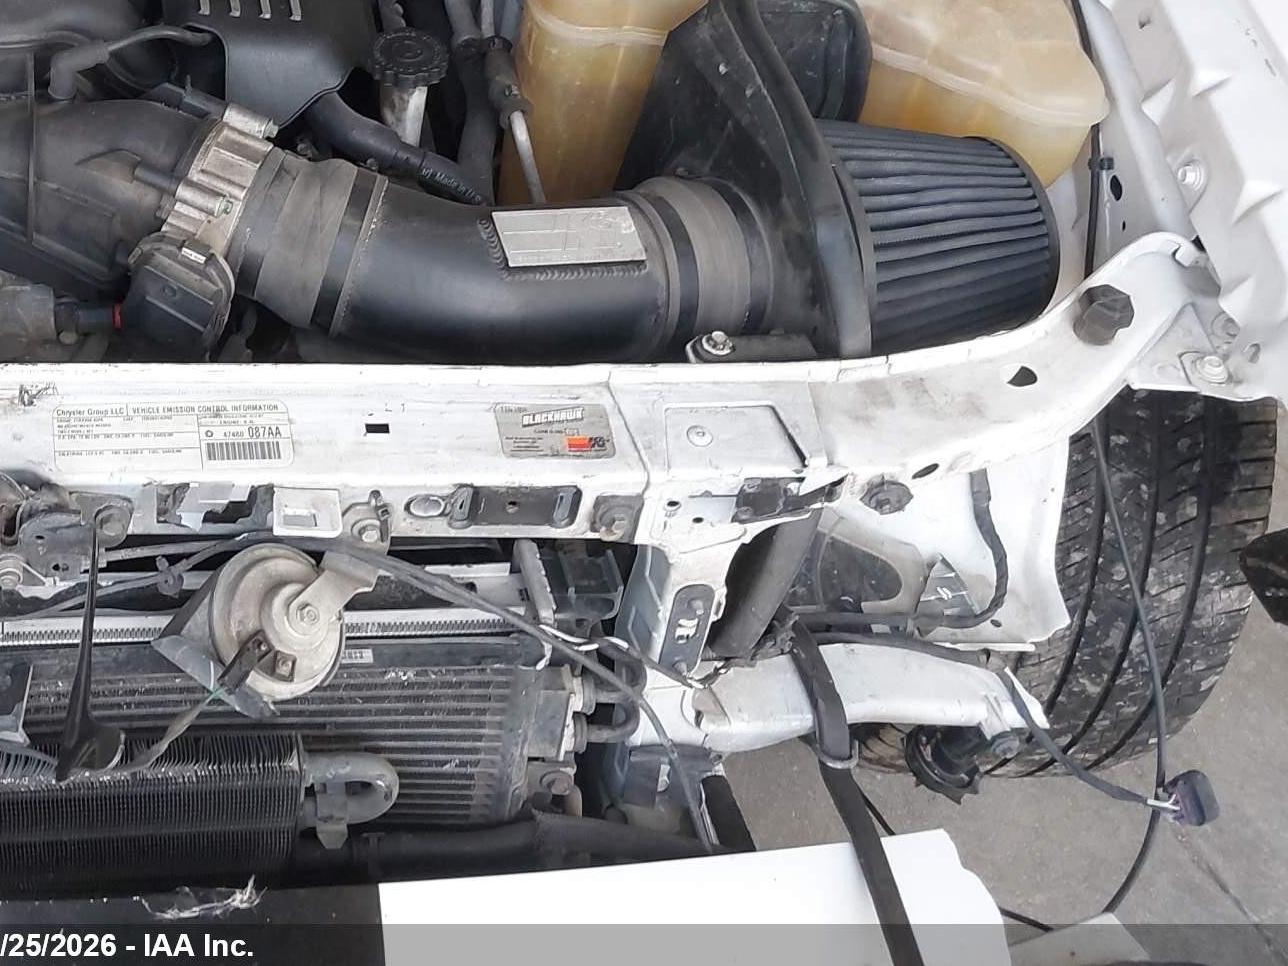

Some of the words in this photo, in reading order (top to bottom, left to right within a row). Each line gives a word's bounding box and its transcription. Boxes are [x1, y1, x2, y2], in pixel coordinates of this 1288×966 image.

[434, 172, 458, 188] Made
[56, 408, 85, 418] Chrysler
[87, 408, 109, 417] Group
[110, 407, 125, 415] LLC
[132, 406, 160, 414] VEHICLE
[162, 405, 196, 414] EMISSION
[197, 404, 229, 413] CONTROL
[231, 403, 279, 412] INFORMATION
[248, 426, 282, 439] 087AA
